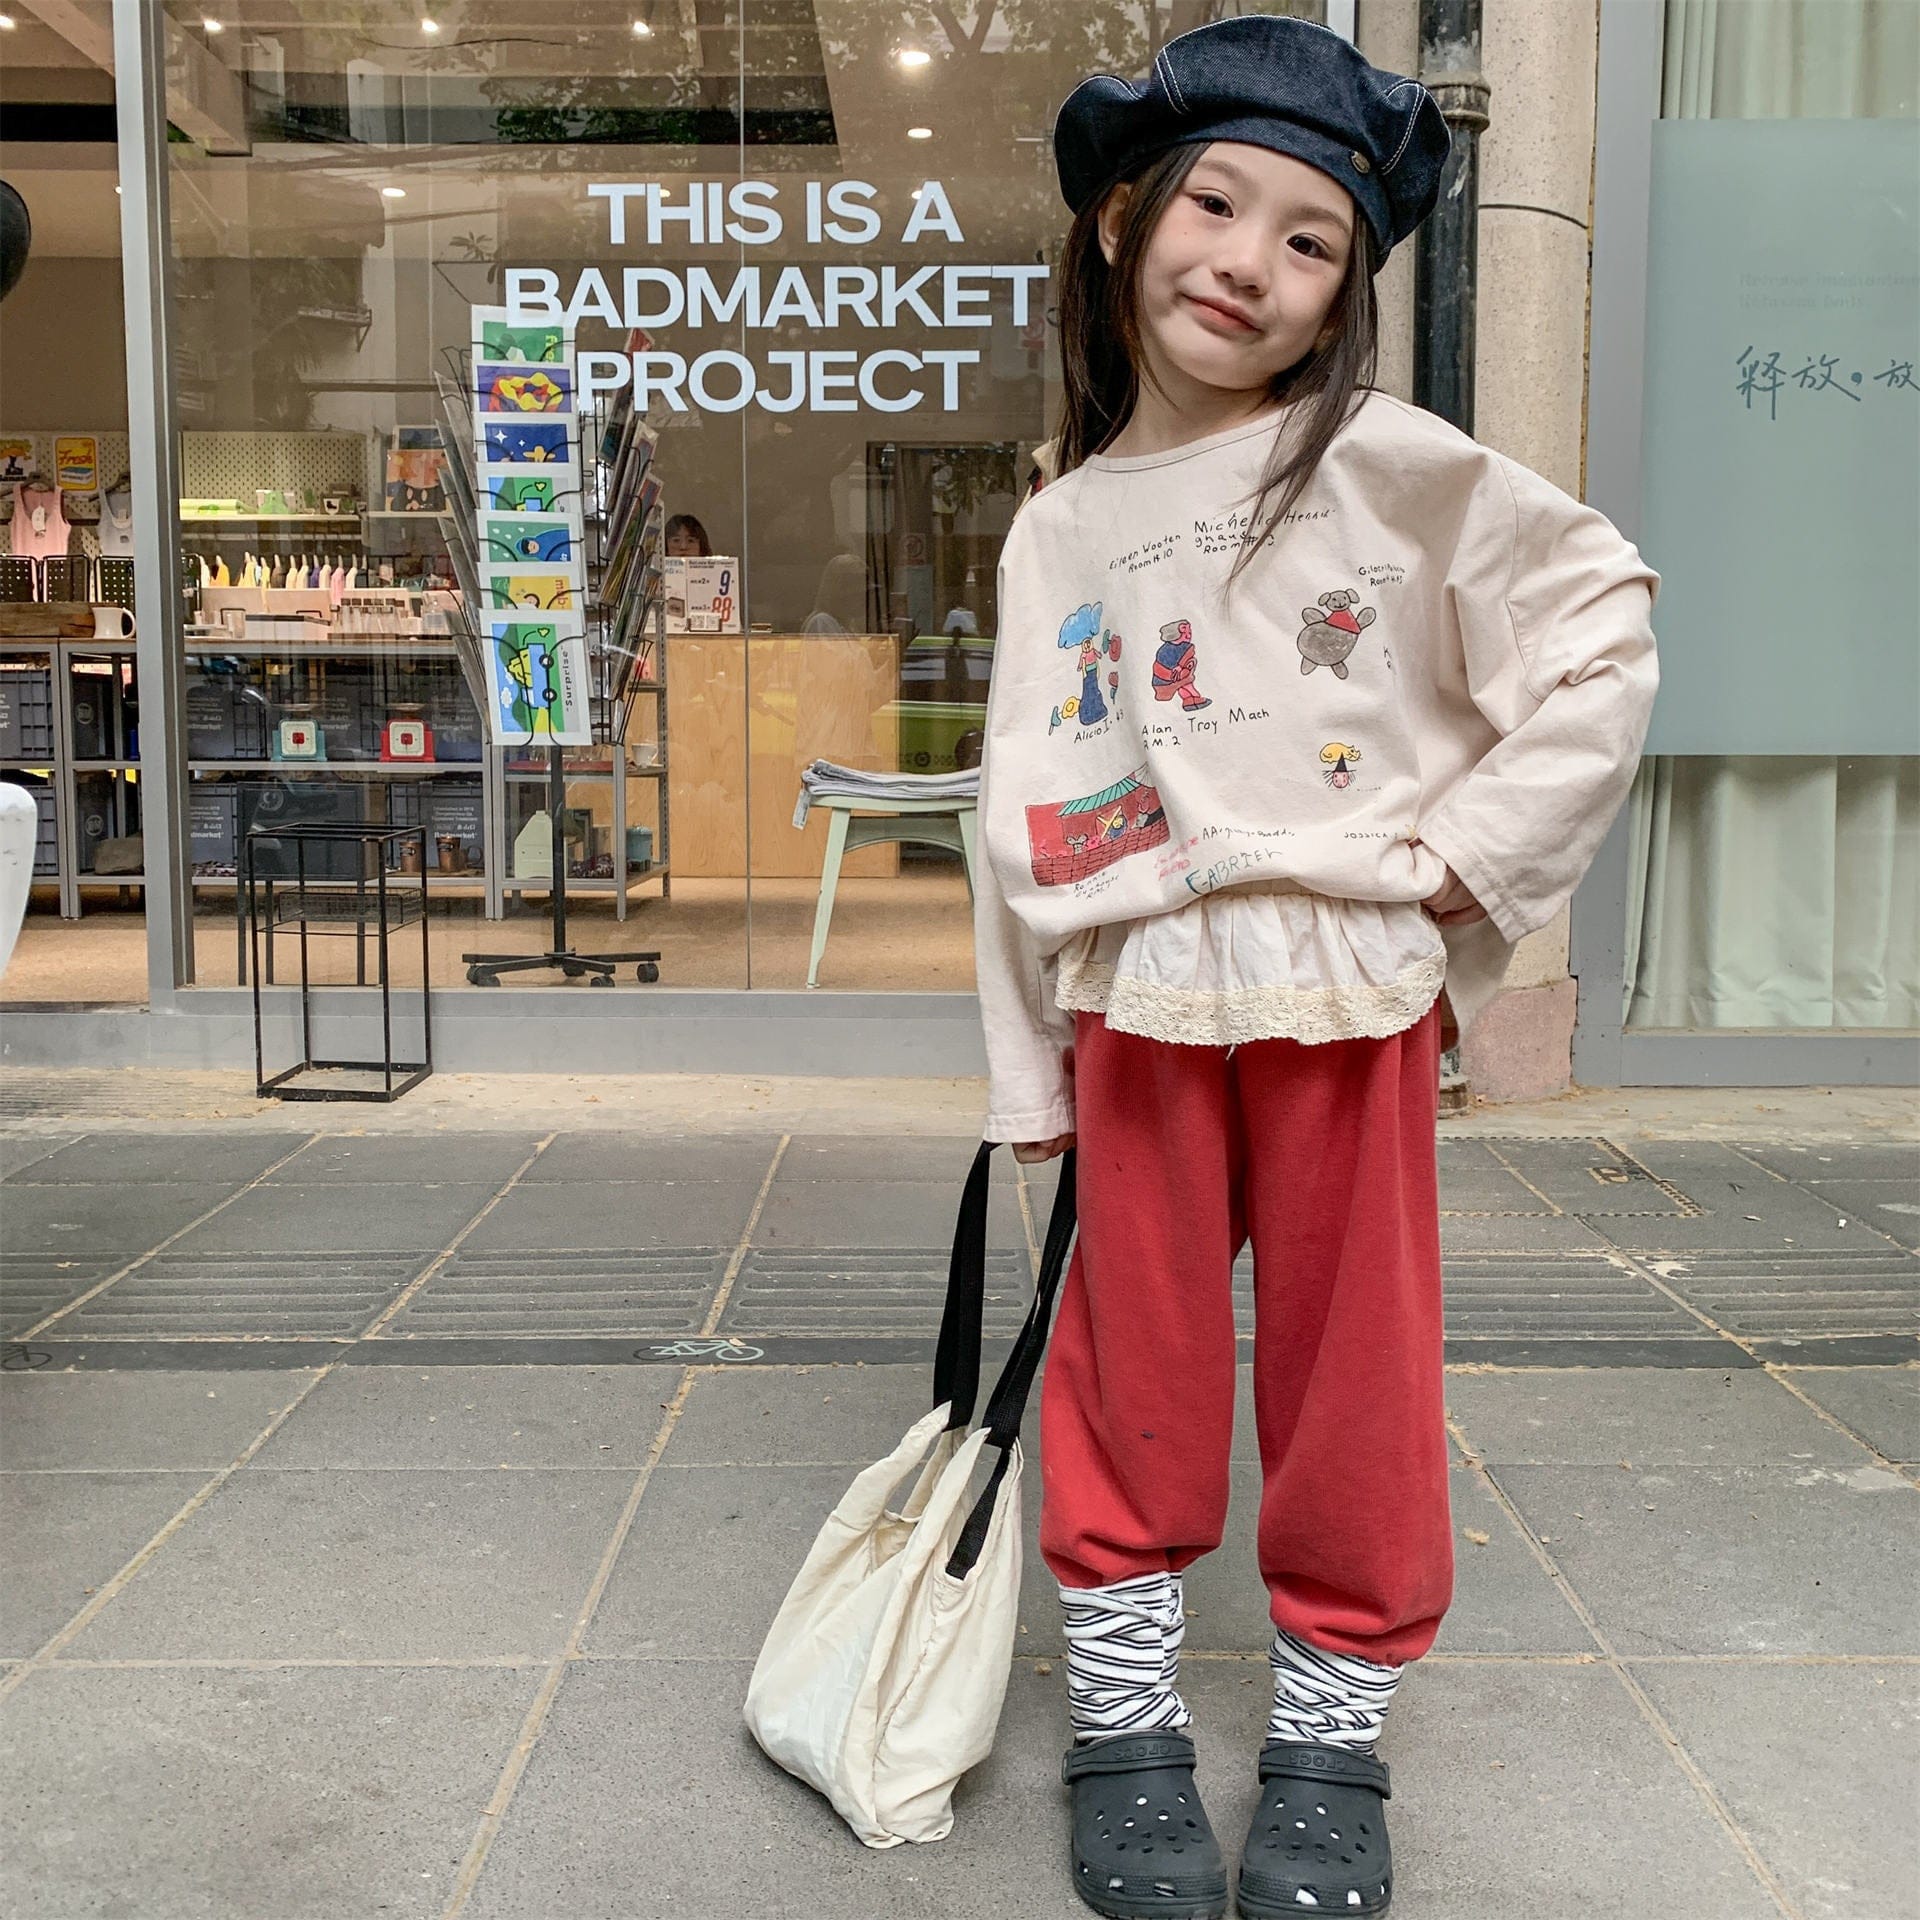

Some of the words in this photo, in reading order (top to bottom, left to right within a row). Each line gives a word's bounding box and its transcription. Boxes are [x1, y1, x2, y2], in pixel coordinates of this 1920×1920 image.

[587, 181, 783, 245] THIS
[805, 180, 882, 244] IS
[901, 180, 965, 243] A
[504, 265, 1051, 328] BADMARKET
[577, 349, 981, 413] PROJECT
[719, 570, 731, 596] 9
[1141, 724, 1172, 736] Alan
[1187, 716, 1218, 735] Troy
[1228, 706, 1270, 724] Mach
